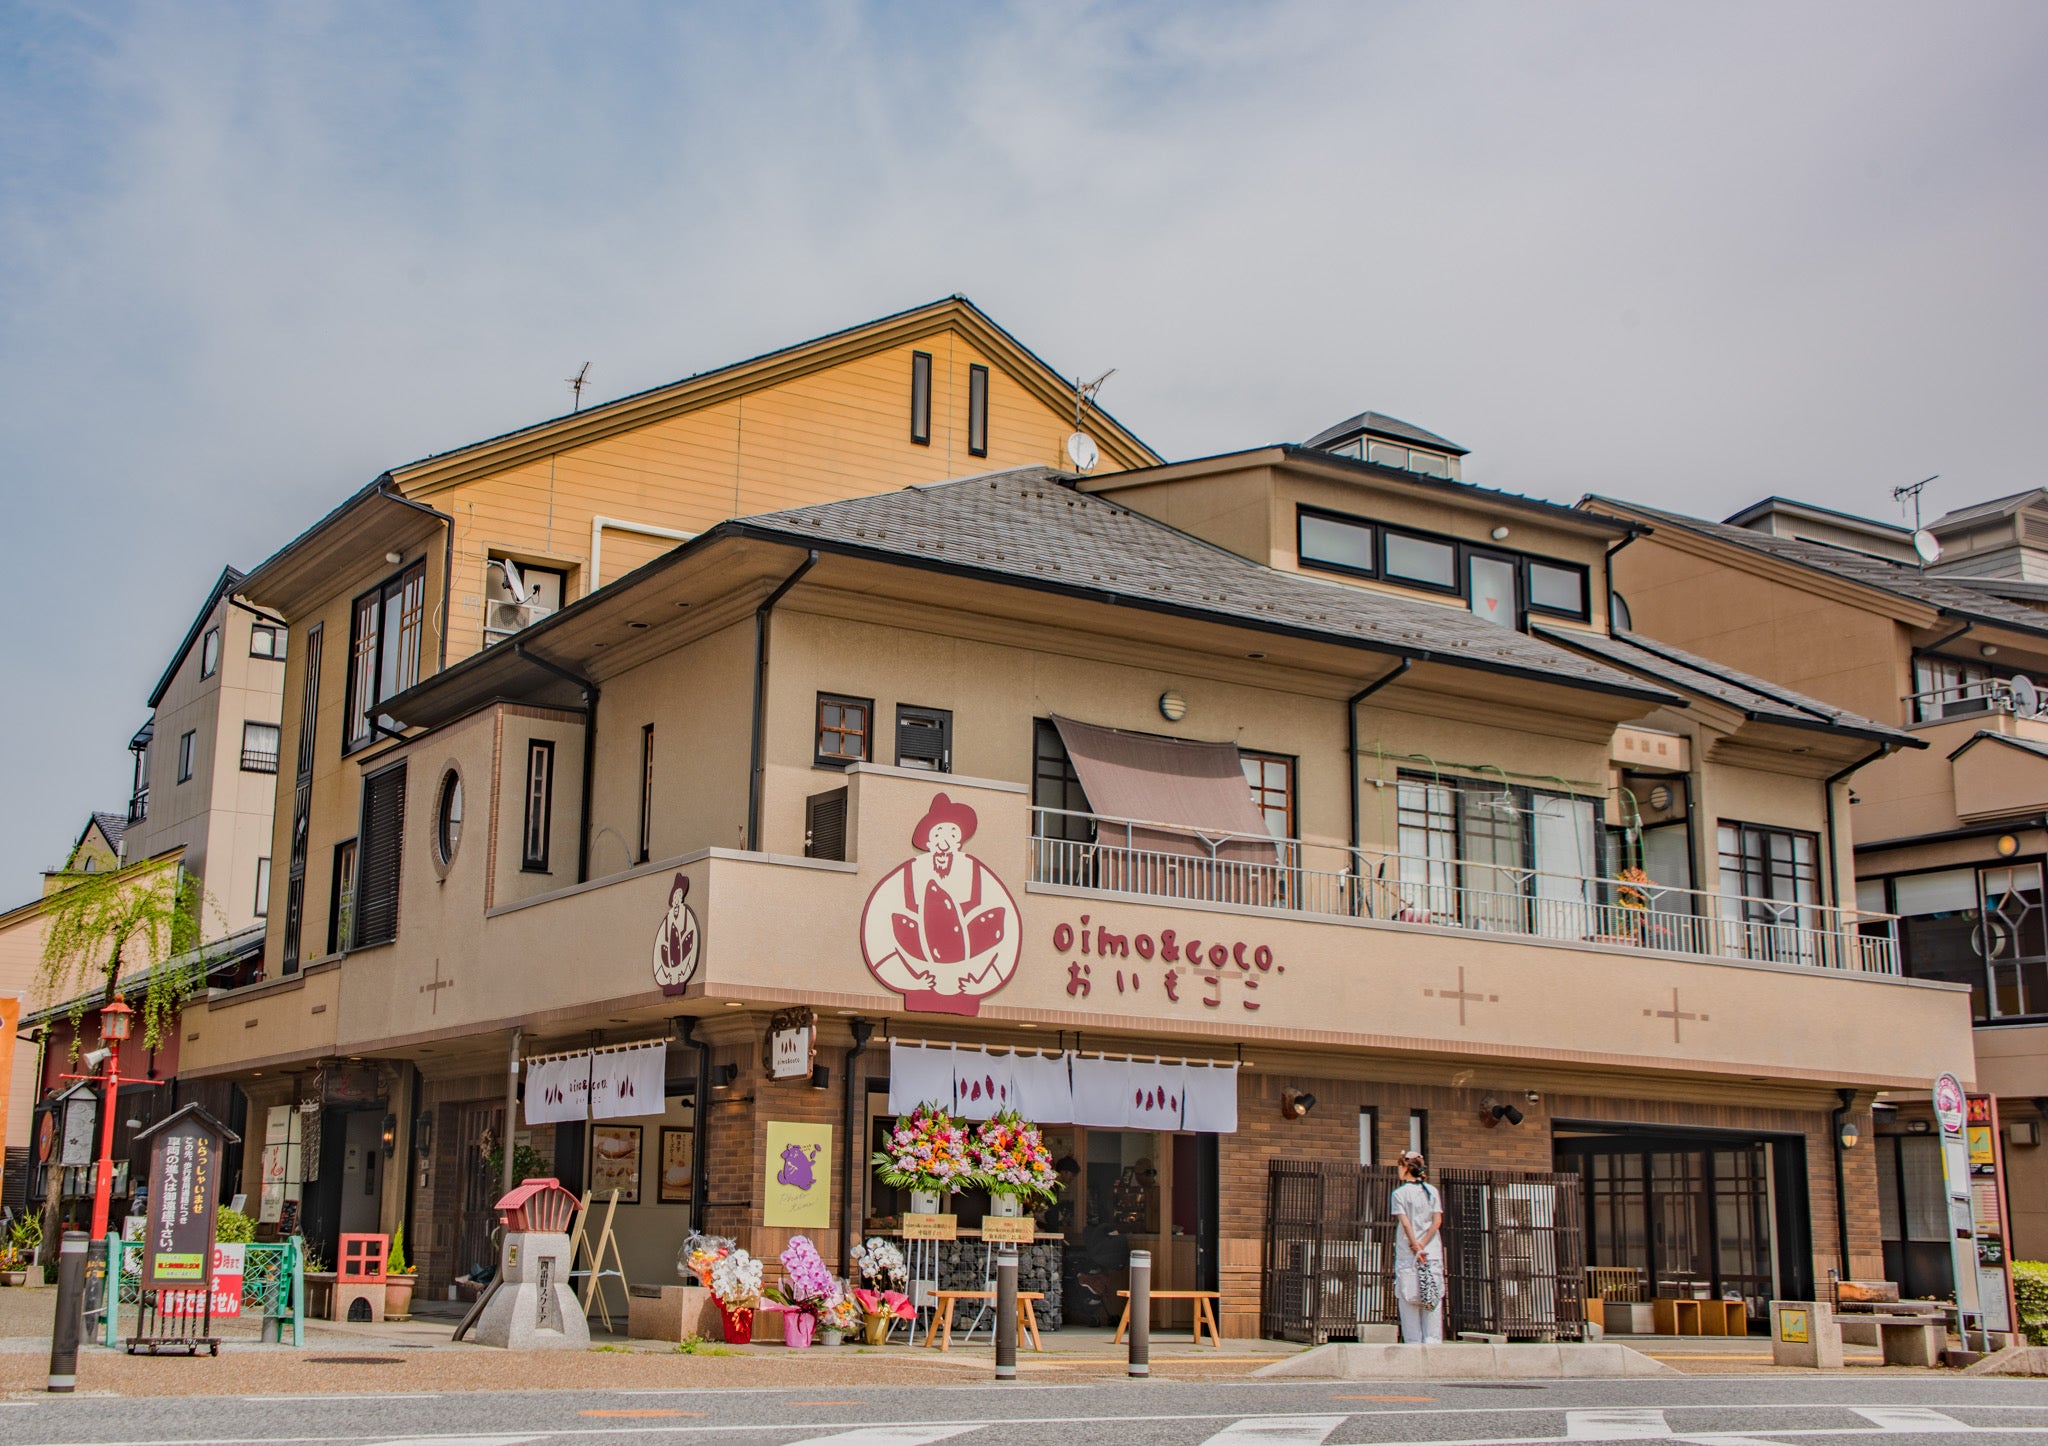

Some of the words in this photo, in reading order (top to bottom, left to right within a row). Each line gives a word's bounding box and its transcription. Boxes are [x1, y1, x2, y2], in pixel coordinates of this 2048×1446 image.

[1053, 914, 1286, 973] oimo&coco.
[1066, 960, 1261, 1010] おいもここ
[193, 1137, 209, 1215] いらっしゃいませ
